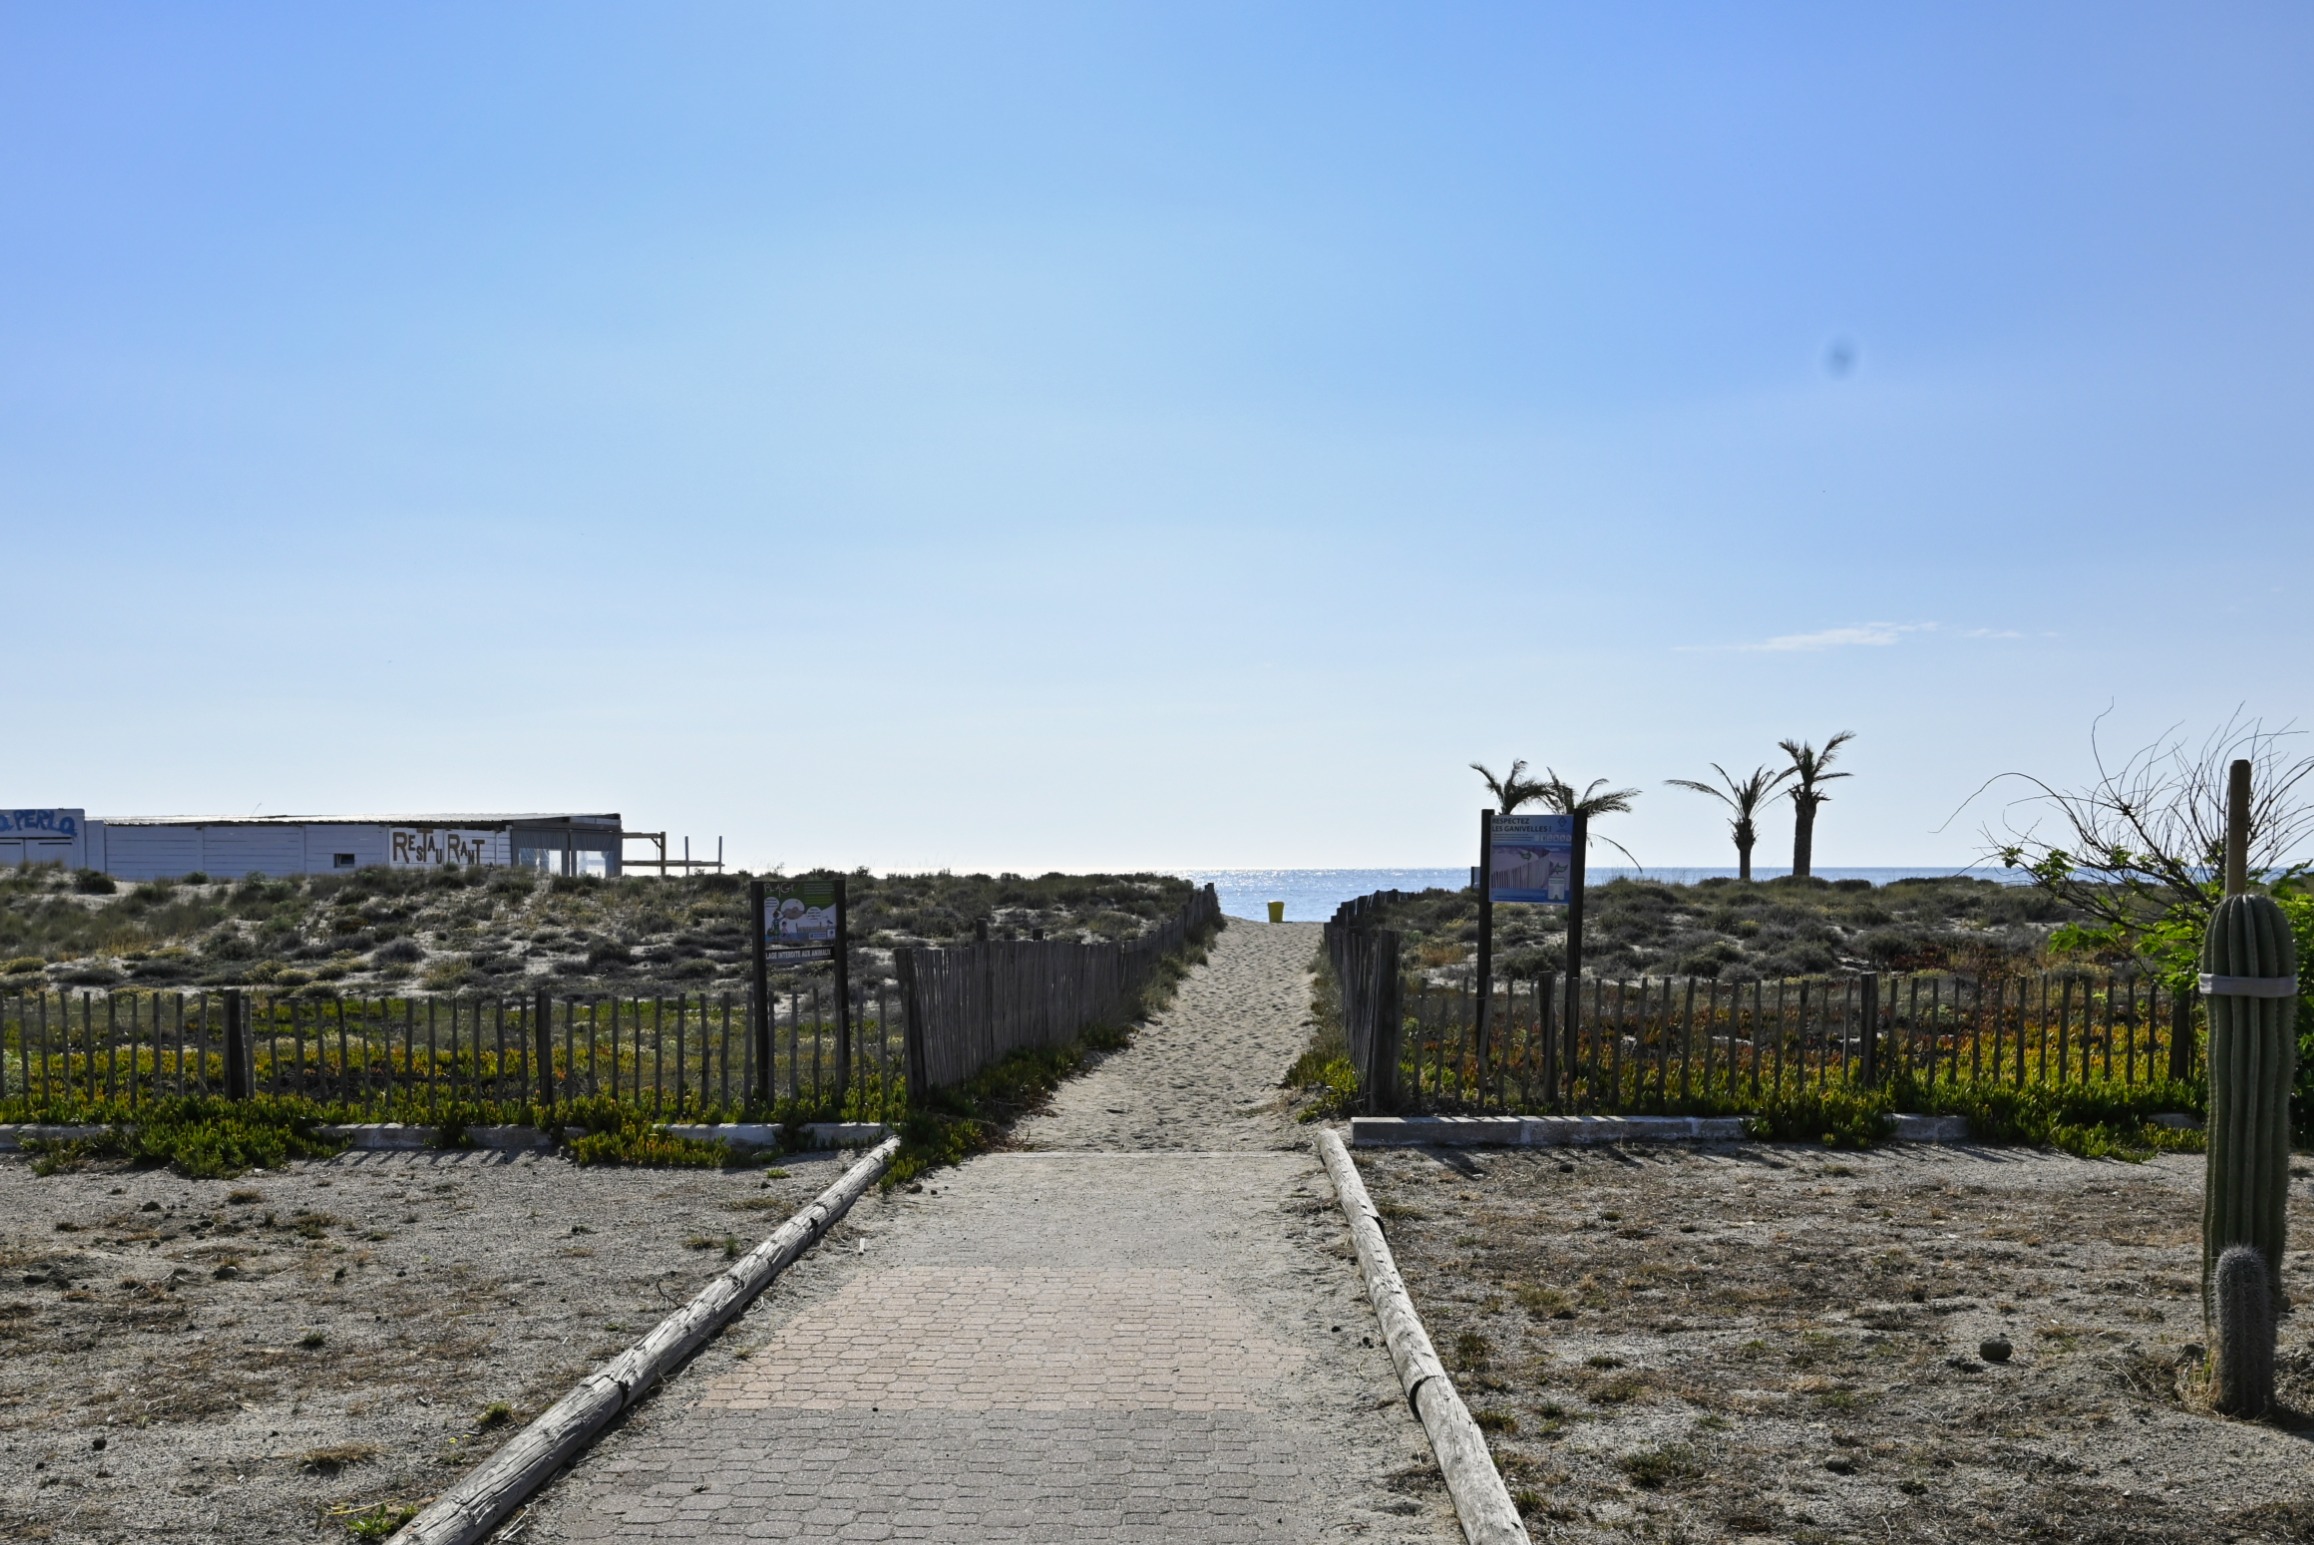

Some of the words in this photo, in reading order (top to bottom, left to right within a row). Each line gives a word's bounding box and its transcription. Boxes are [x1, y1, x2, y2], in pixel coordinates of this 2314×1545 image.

[1491, 817, 1530, 825] RESPECTEZ
[1491, 825, 1503, 833] LES
[1504, 825, 1547, 833] GANIVELLES
[392, 828, 485, 865] RESTAURANT
[765, 951, 778, 960] LAGE
[778, 950, 801, 959] INTERDITE
[801, 950, 811, 958] AUX
[811, 948, 832, 957] ANIMAUX
